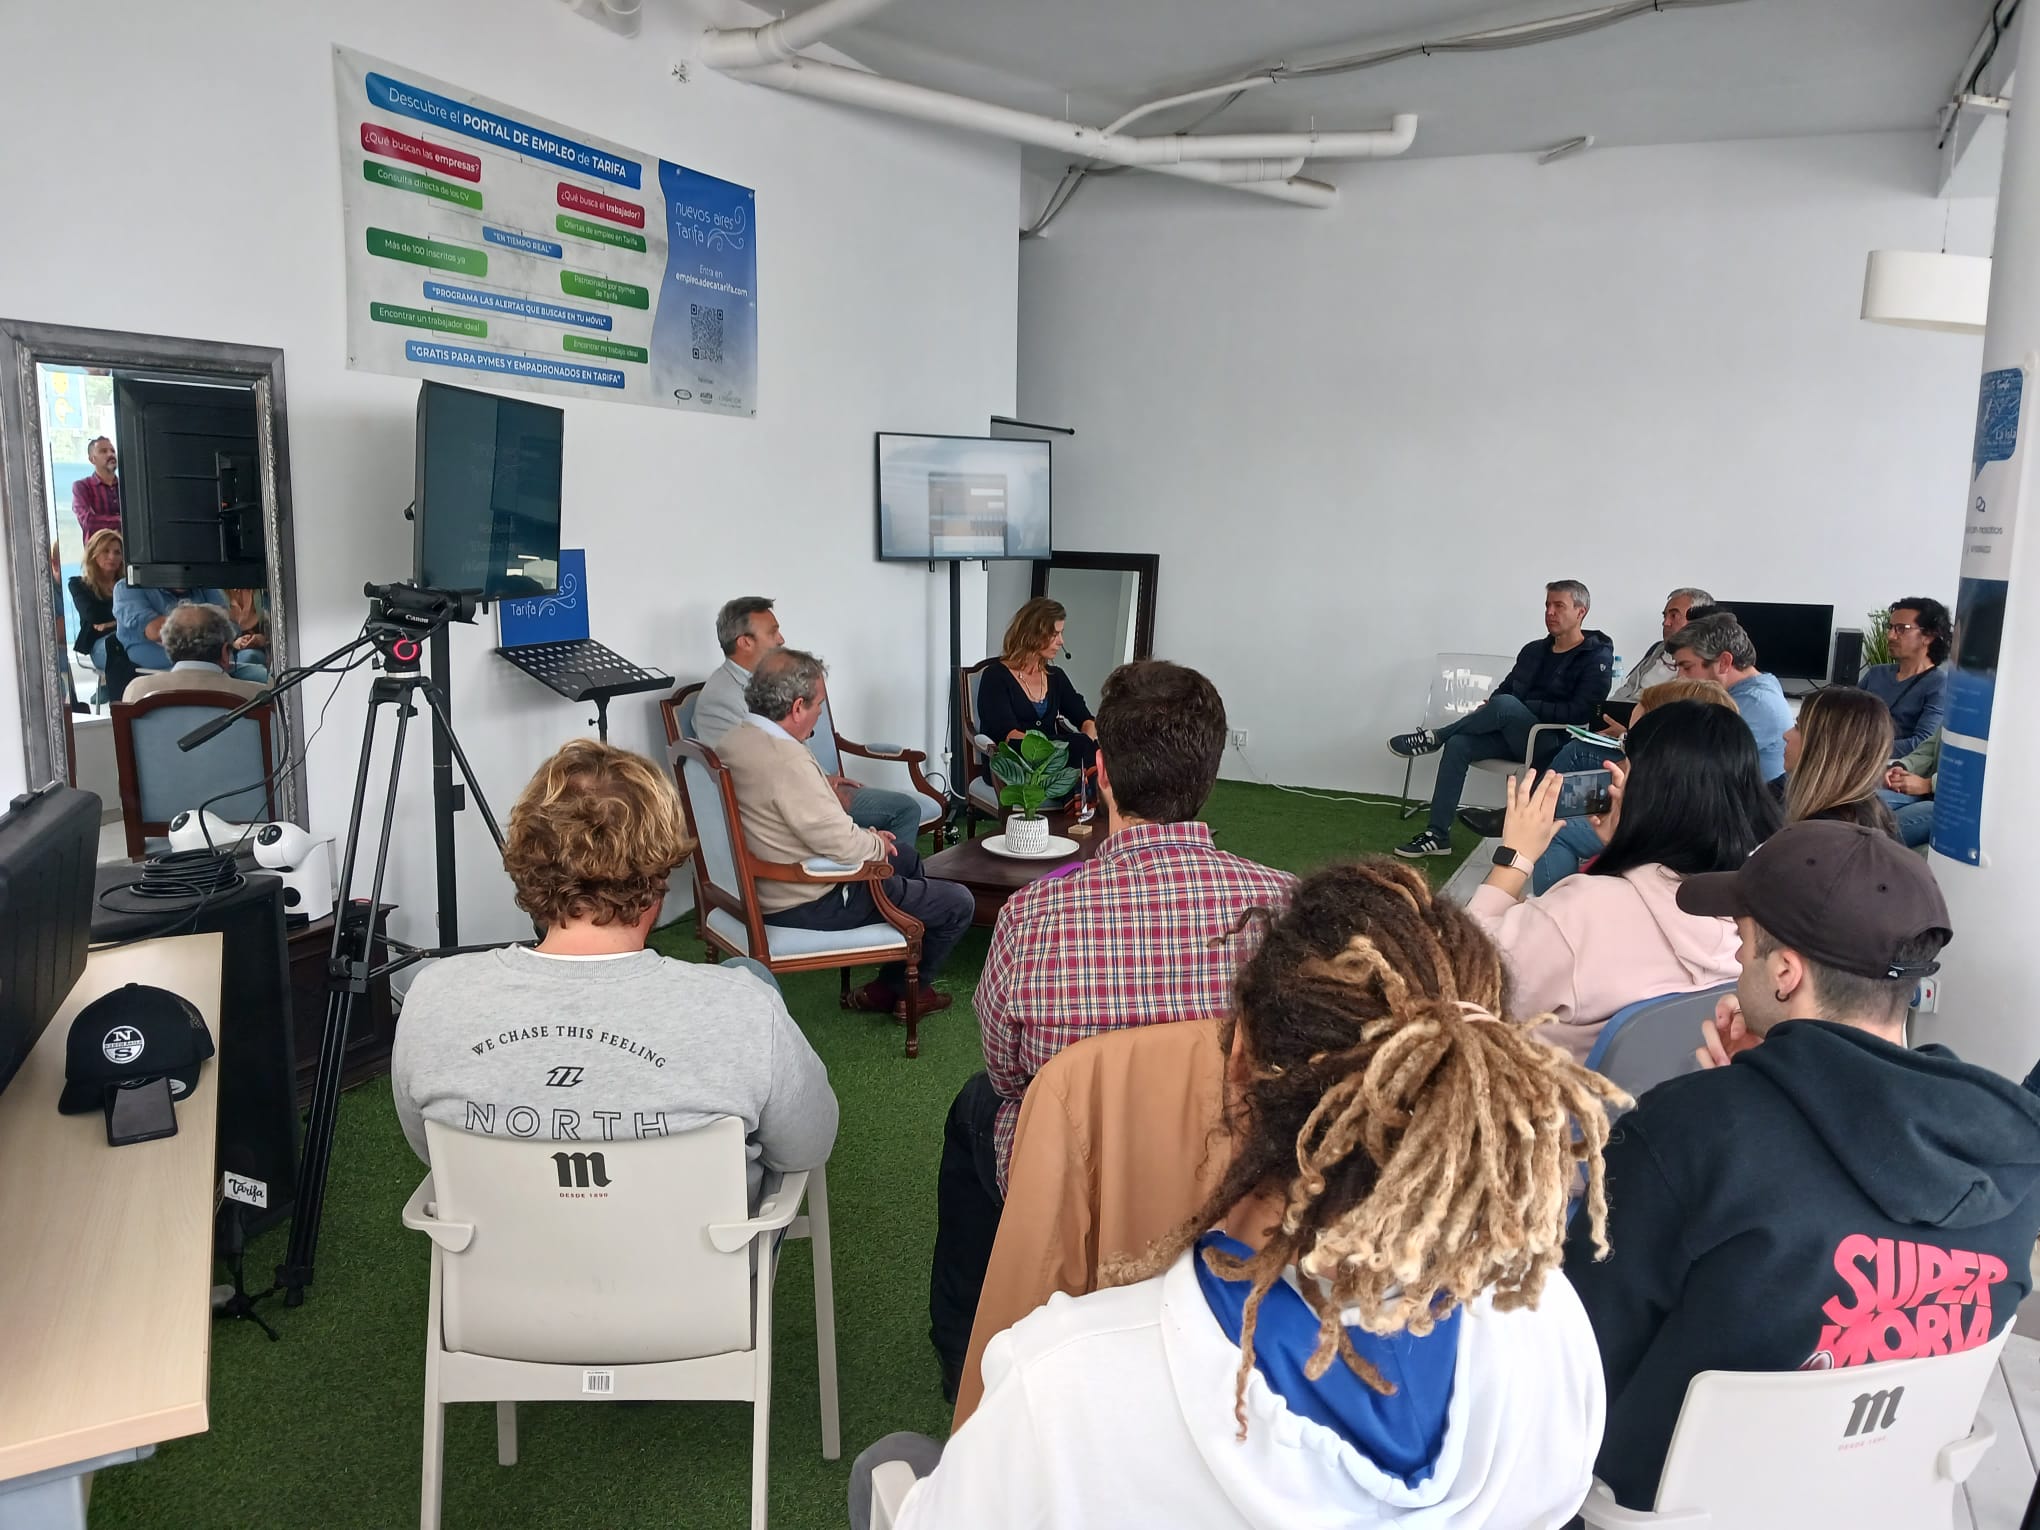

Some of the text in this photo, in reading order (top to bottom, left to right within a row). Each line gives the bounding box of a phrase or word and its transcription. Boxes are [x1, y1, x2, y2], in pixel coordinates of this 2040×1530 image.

[389, 87, 627, 178] Descubre el PORTAL DE EMPLEO de TARIFA
[365, 131, 479, 173] ¿Qué buscan las empresas?
[378, 169, 412, 186] Consulta
[414, 179, 439, 193] directa
[441, 187, 449, 195] de
[460, 192, 469, 201] CV
[561, 190, 578, 203] ¿Qué
[580, 194, 598, 208] busca
[606, 203, 641, 220] trabajador?
[675, 202, 734, 230] nuevos aires
[384, 239, 400, 250] Más
[401, 243, 411, 253] de
[412, 244, 425, 256] 100
[507, 235, 532, 249] TIEMPO
[676, 222, 704, 247] Tarifa
[699, 264, 723, 279] Entra en
[379, 306, 480, 332] Encontrar un trabajador ideal
[480, 296, 493, 306] LAS
[495, 298, 524, 312] ALERTAS
[526, 304, 540, 315] QUE
[541, 307, 566, 320] BUSCAS
[567, 313, 576, 321] EN
[576, 314, 585, 322] TU
[451, 351, 476, 364] PARA
[477, 354, 505, 369] PYMES
[506, 359, 513, 369] Y
[514, 360, 580, 379] EMPADRONADOS
[581, 370, 593, 380] EN
[405, 614, 429, 624] Canon
[511, 601, 537, 619] Tarifa
[113, 1030, 133, 1042] N
[472, 1025, 667, 1069] WE CHASE THIS FEELING
[115, 1048, 132, 1059] S
[465, 1101, 670, 1141] NORTH
[229, 1178, 264, 1202] Tarifa
[1821, 1233, 2009, 1328] SUPER
